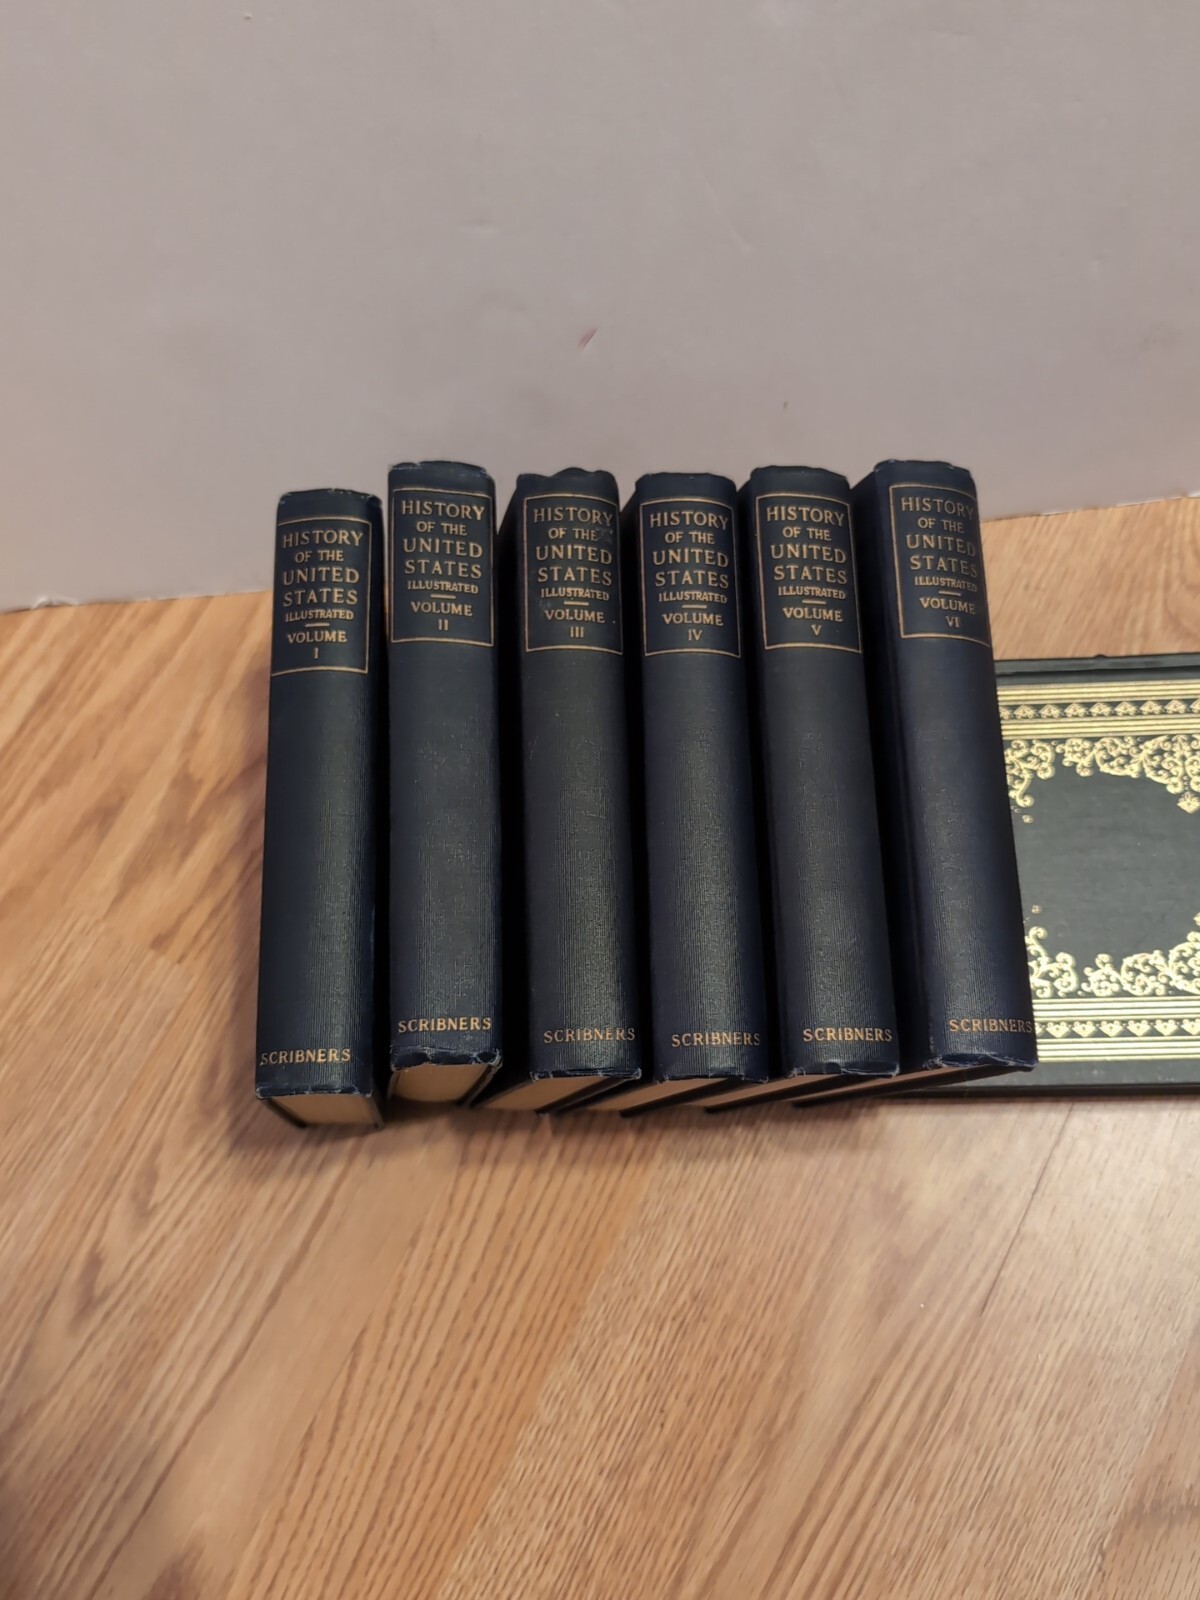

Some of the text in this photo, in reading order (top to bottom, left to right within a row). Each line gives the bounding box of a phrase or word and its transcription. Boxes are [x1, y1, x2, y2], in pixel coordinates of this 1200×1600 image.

[402, 500, 484, 520] HISTORY
[767, 506, 844, 527] HISTORY
[901, 497, 974, 520] HISTORY
[533, 507, 613, 527] HISTORY
[650, 510, 728, 530] HISTORY
[918, 517, 965, 533] OF THE
[416, 520, 467, 536] OF THE
[548, 527, 598, 541] OF THE
[782, 527, 832, 541] OF THE
[282, 530, 363, 549] HISTORY
[665, 531, 715, 544] OF THE
[906, 534, 976, 557] UNITED
[403, 538, 483, 558] UNITED
[536, 544, 612, 565] UNITED
[770, 544, 846, 564] UNITED
[295, 550, 344, 563] OF THE
[653, 547, 729, 567] UNITED
[405, 559, 482, 579] STATES
[774, 565, 847, 584] STATES
[910, 555, 977, 578] STATES
[283, 567, 360, 586] UNITED
[538, 566, 612, 586] STATES
[655, 570, 729, 589] STATES
[915, 575, 977, 592] ILLUSTRATED
[408, 580, 479, 594] ILLUSTRATED
[541, 587, 609, 601] ILLUSTRATED
[778, 585, 845, 600] ILLUSTRATED
[283, 588, 358, 607] STATES
[659, 591, 727, 604] ILLUSTRATED
[411, 601, 473, 616] VOLUME
[919, 597, 976, 615] VOLUME
[285, 609, 354, 622] ILLUSTRATED
[544, 609, 605, 623] VOLUME
[662, 612, 724, 626] VOLUME
[783, 607, 843, 622] VOLUME
[946, 615, 960, 628] VI
[438, 619, 449, 631] II
[569, 626, 584, 638] III
[811, 624, 822, 636] V
[287, 630, 347, 644] VOLUME
[688, 629, 702, 641] IV
[398, 1017, 491, 1033] SCRIBNERS
[950, 1019, 1032, 1033] SCRIBNERS
[544, 1028, 635, 1043] SCRIBNERS
[671, 1032, 760, 1047] SCRIBNERS
[803, 1028, 893, 1043] SCRIBNERS
[260, 1049, 350, 1065] SCRIBNERS
